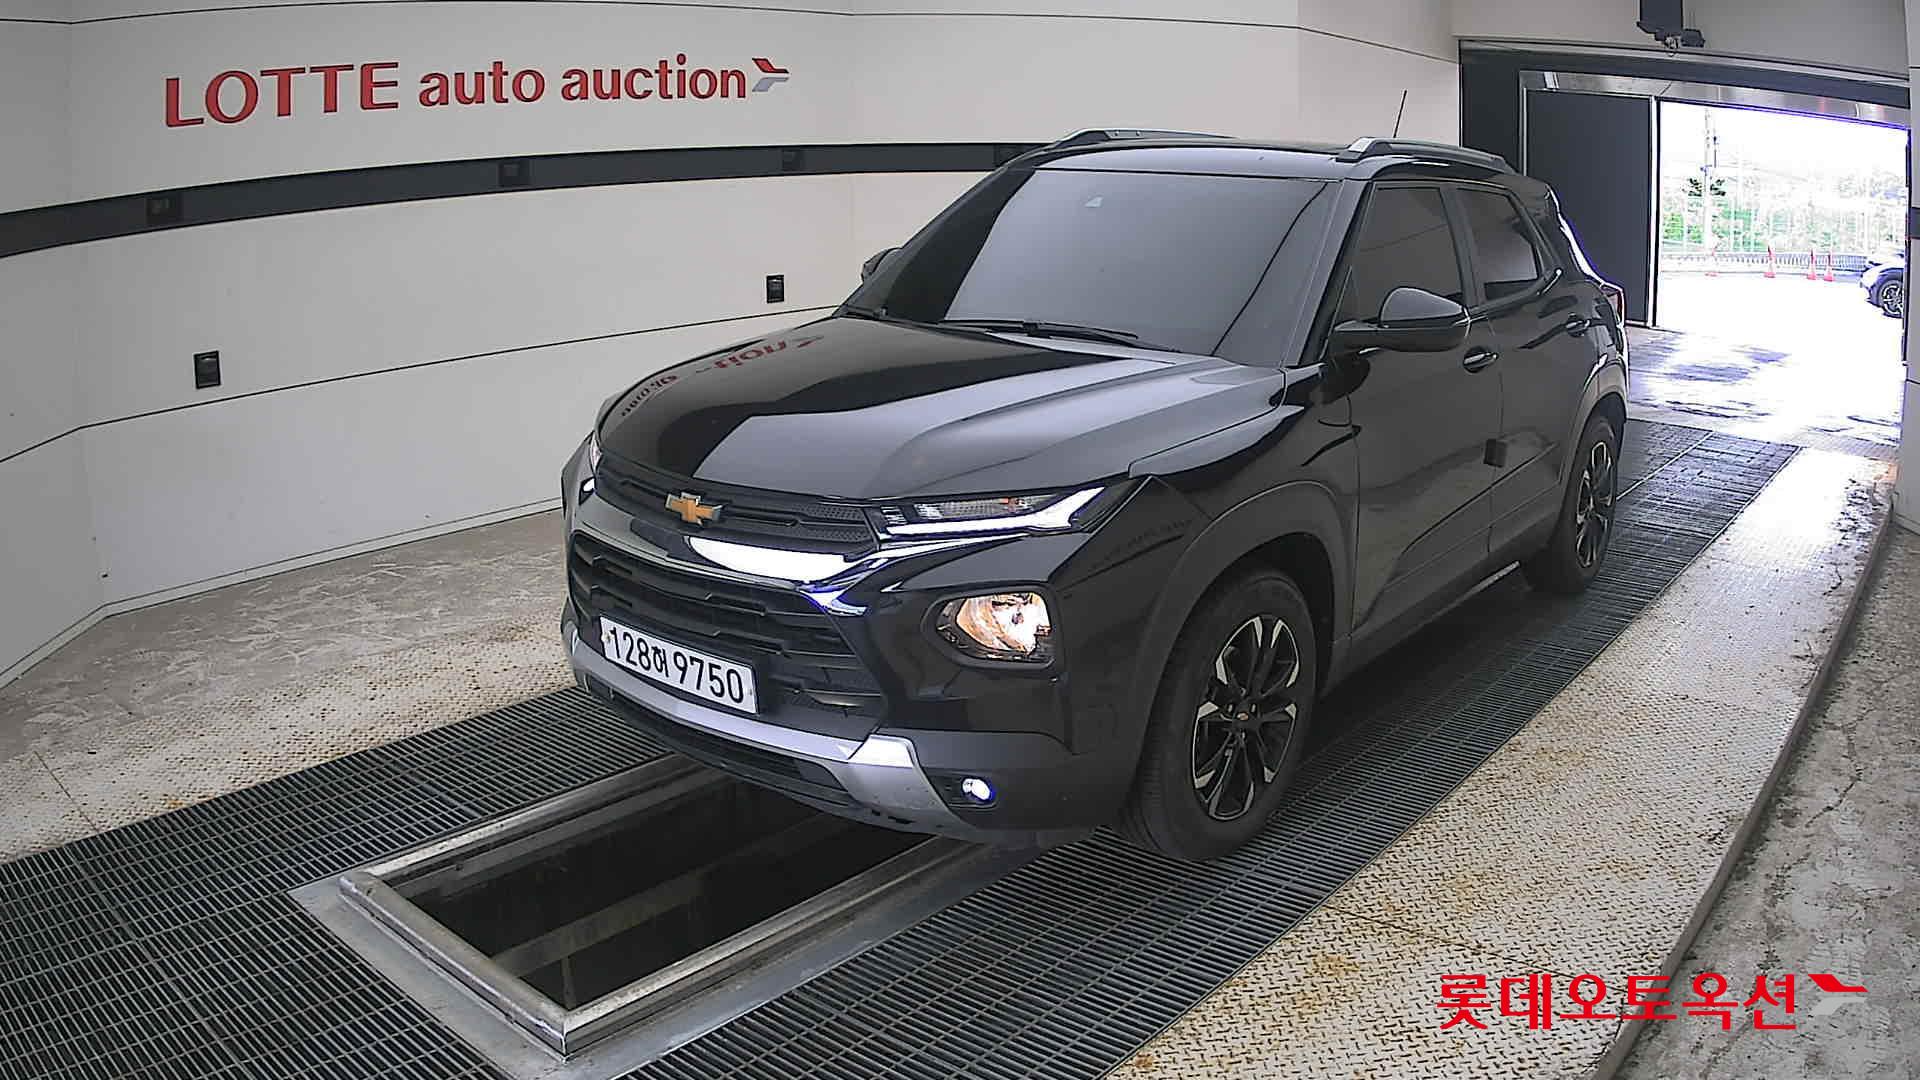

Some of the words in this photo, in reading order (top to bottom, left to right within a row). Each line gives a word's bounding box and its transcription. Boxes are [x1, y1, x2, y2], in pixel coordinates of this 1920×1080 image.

[164, 62, 400, 128] LOTTE
[418, 60, 546, 108] auto
[560, 53, 748, 102] auction
[609, 626, 670, 678] 128허
[673, 650, 744, 704] 9750
